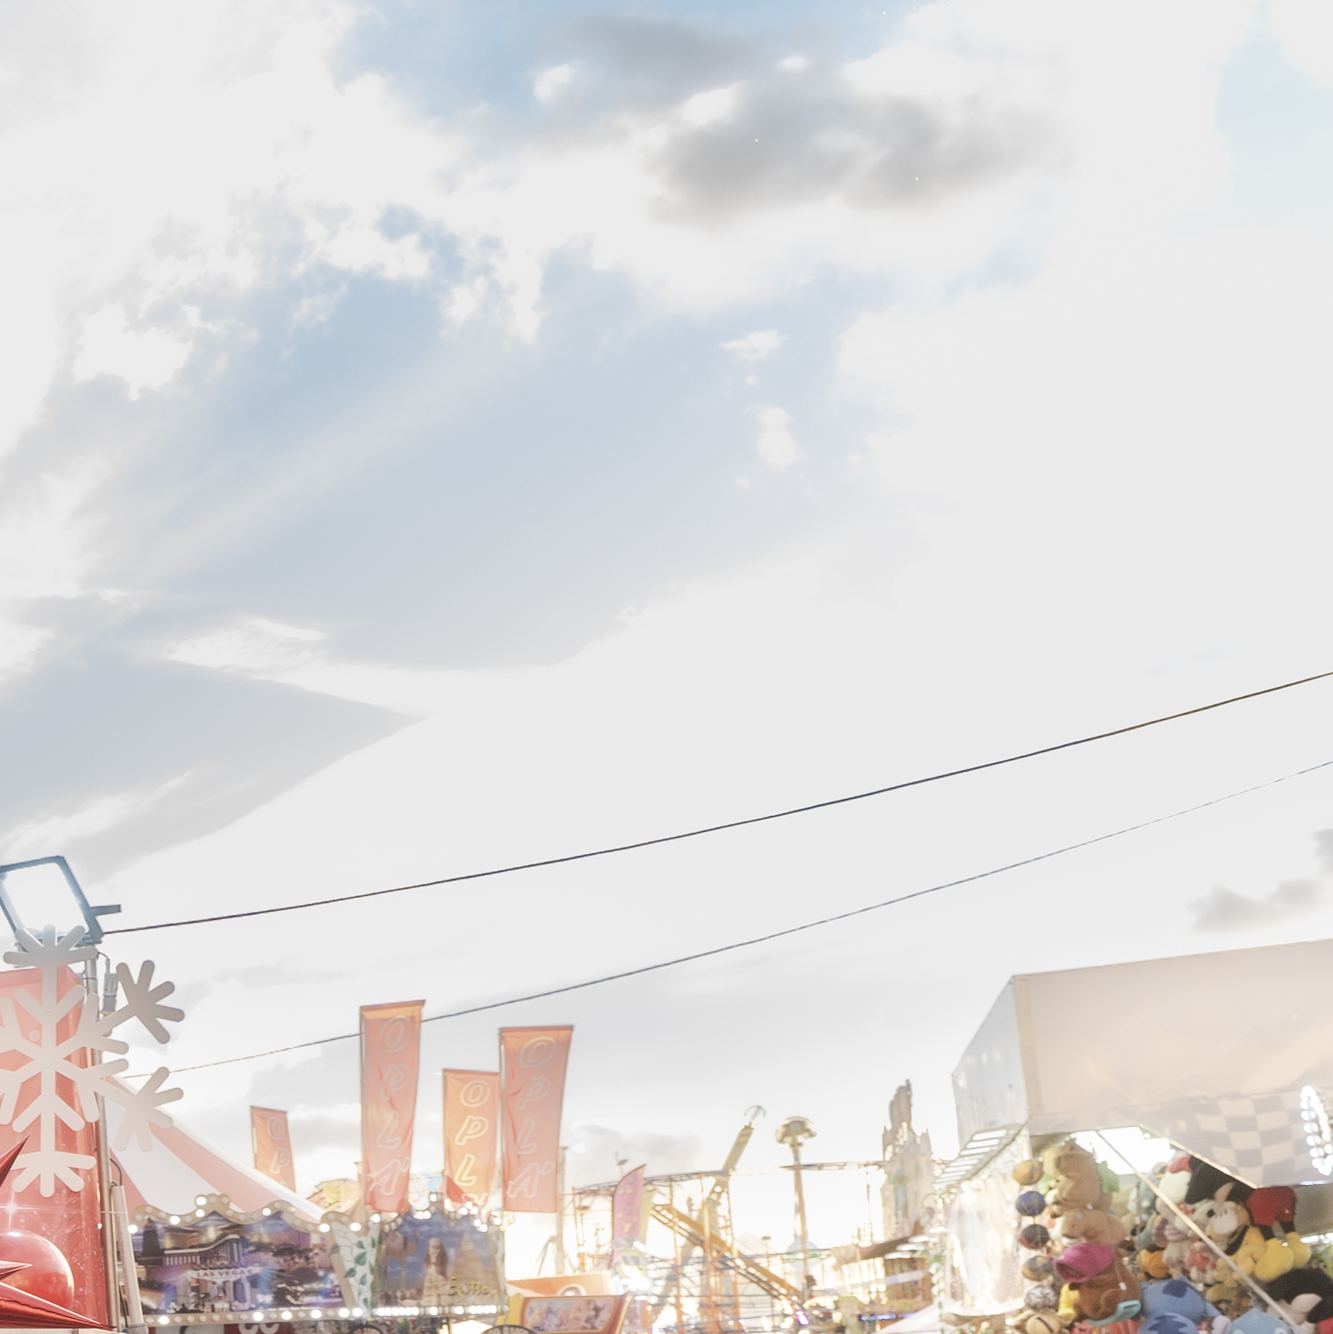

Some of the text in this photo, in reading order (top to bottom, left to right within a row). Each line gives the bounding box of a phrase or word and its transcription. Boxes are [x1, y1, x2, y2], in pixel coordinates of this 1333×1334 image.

[266, 1116, 291, 1177] OP
[454, 1080, 492, 1200] OPL
[218, 1269, 253, 1277] VEGAS
